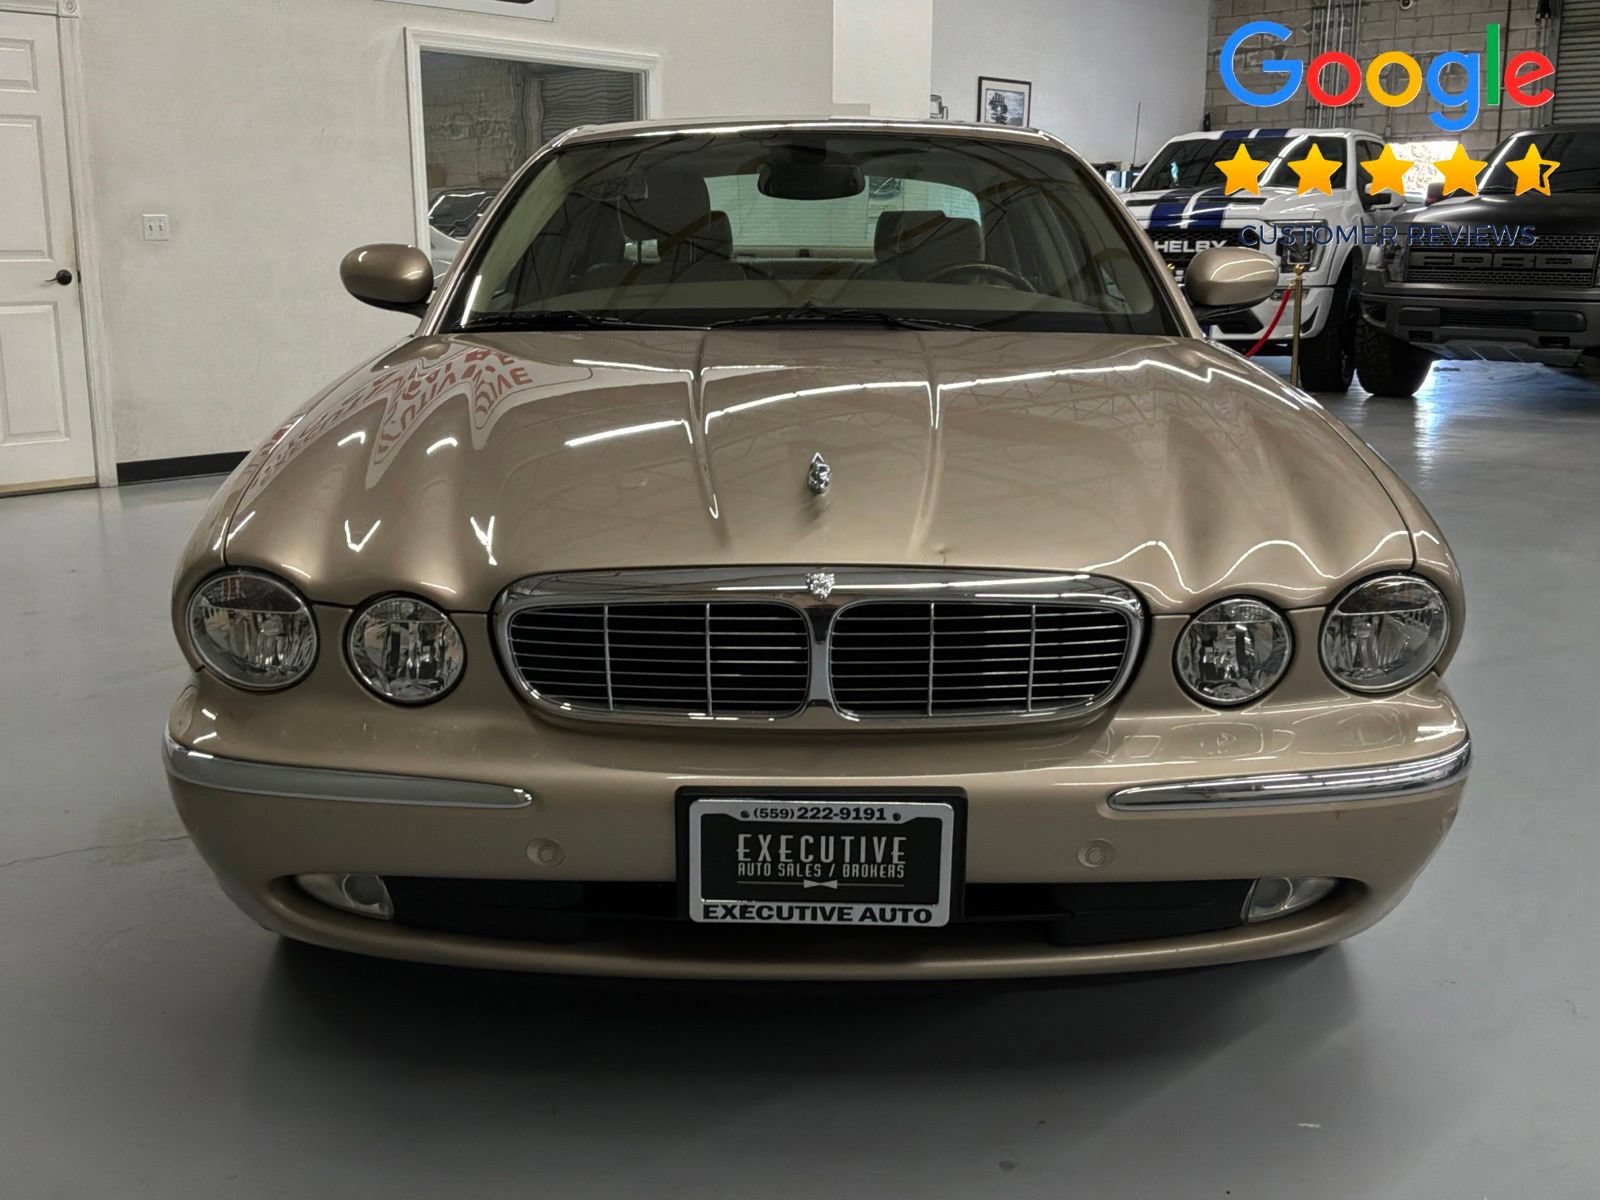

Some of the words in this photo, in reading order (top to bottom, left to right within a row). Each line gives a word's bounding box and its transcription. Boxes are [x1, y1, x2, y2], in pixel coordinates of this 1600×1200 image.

[1154, 240, 1227, 253] HELBY
[736, 833, 907, 865] EXECUTIVE
[738, 862, 772, 877] AUTO
[778, 863, 822, 878] SALES
[842, 864, 905, 879] BROKERS
[702, 904, 854, 922] EXECUTIVE
[858, 906, 932, 924] AUTO
